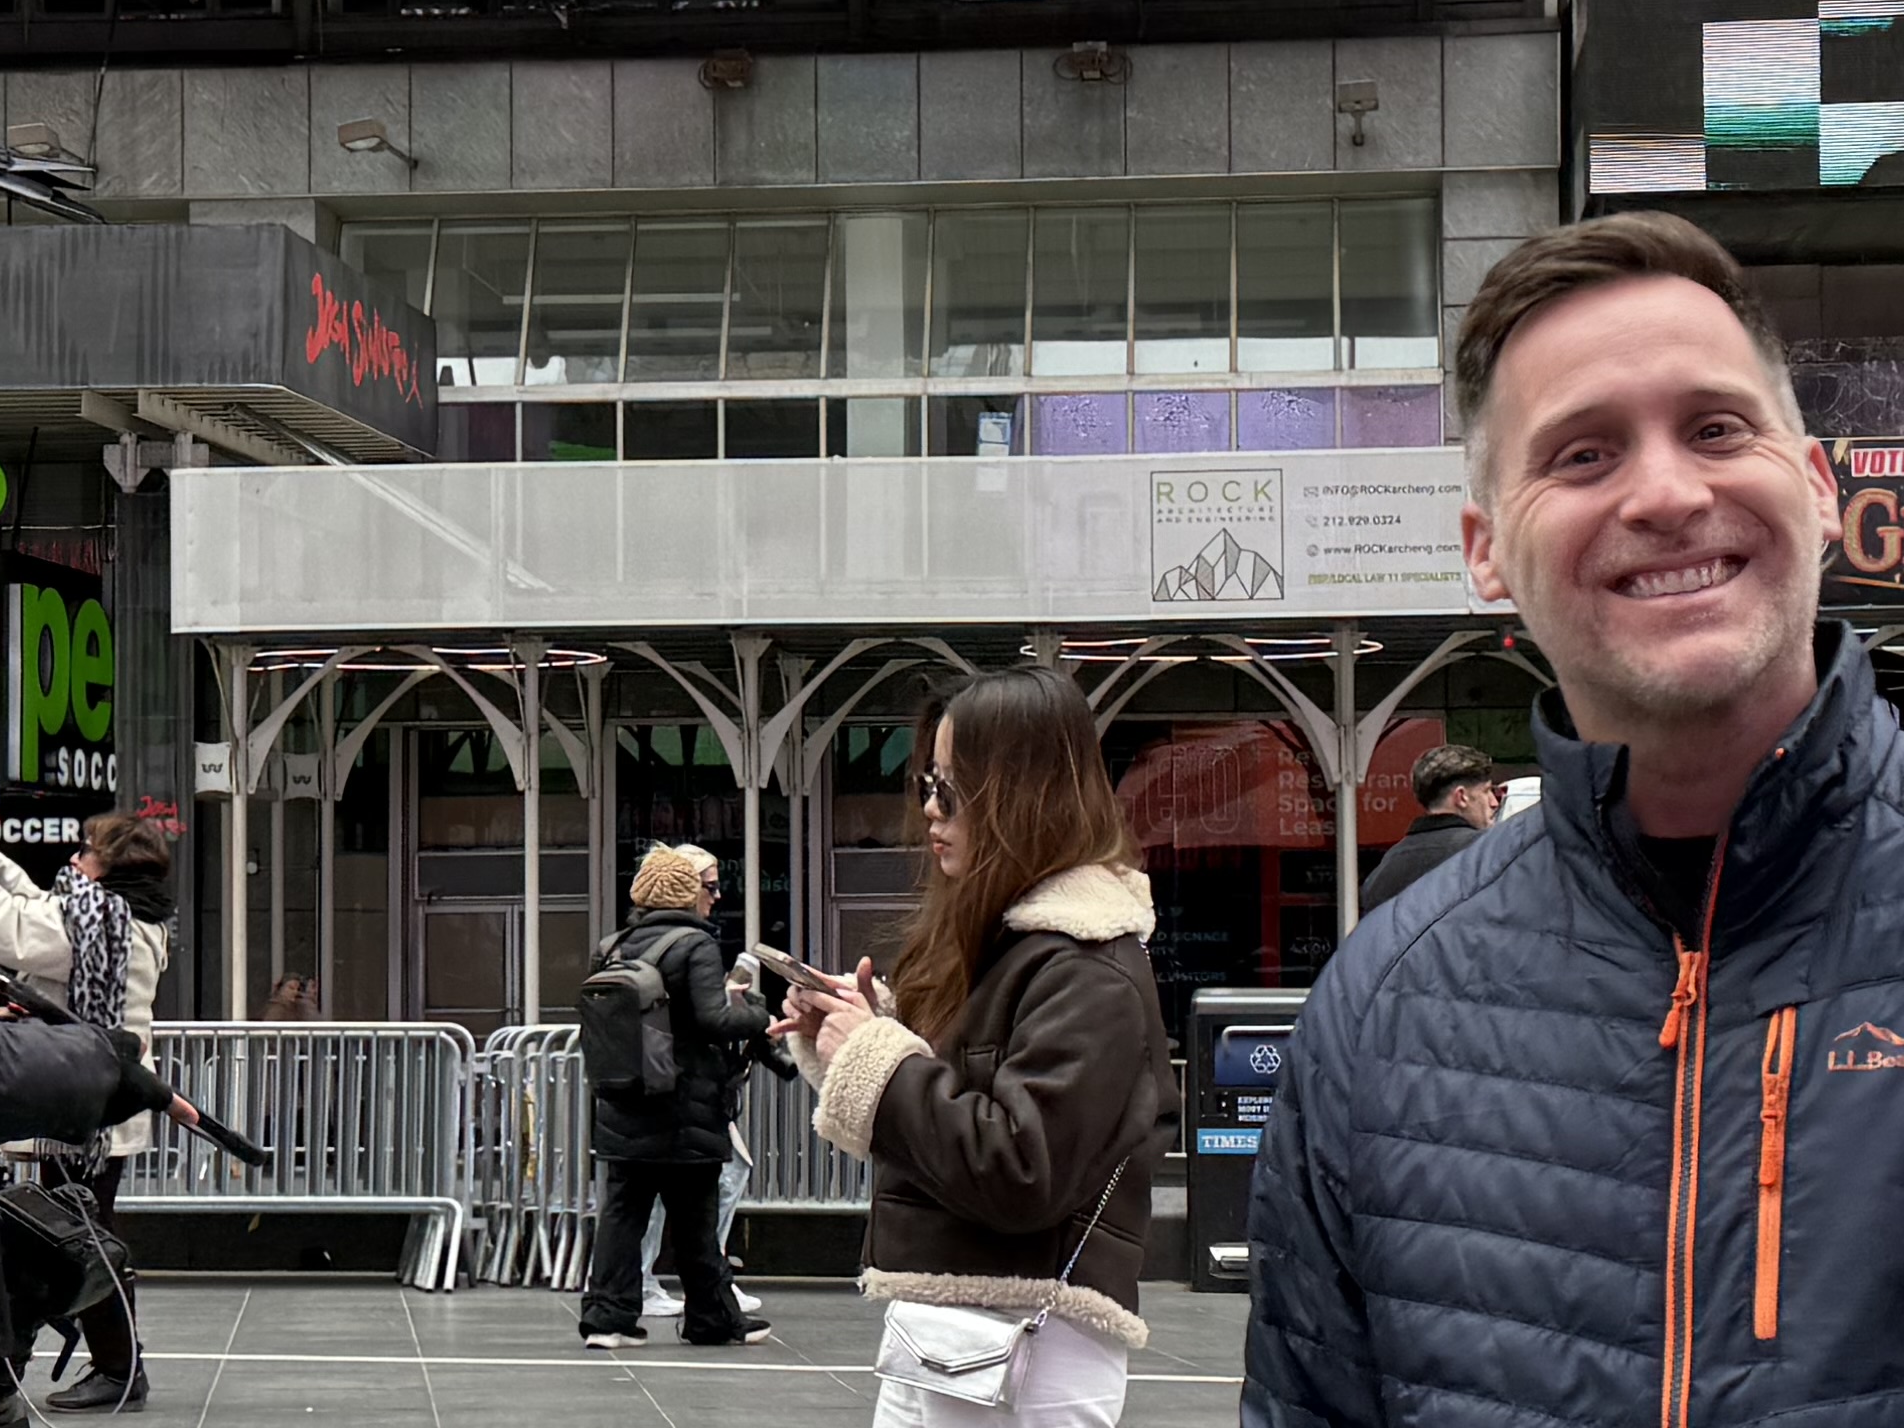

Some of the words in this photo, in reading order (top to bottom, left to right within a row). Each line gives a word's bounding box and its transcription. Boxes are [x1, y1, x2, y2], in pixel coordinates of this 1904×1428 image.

[1156, 479, 1273, 503] ROCK
[1363, 793, 1398, 813] for
[1202, 1134, 1259, 1150] TIMES
